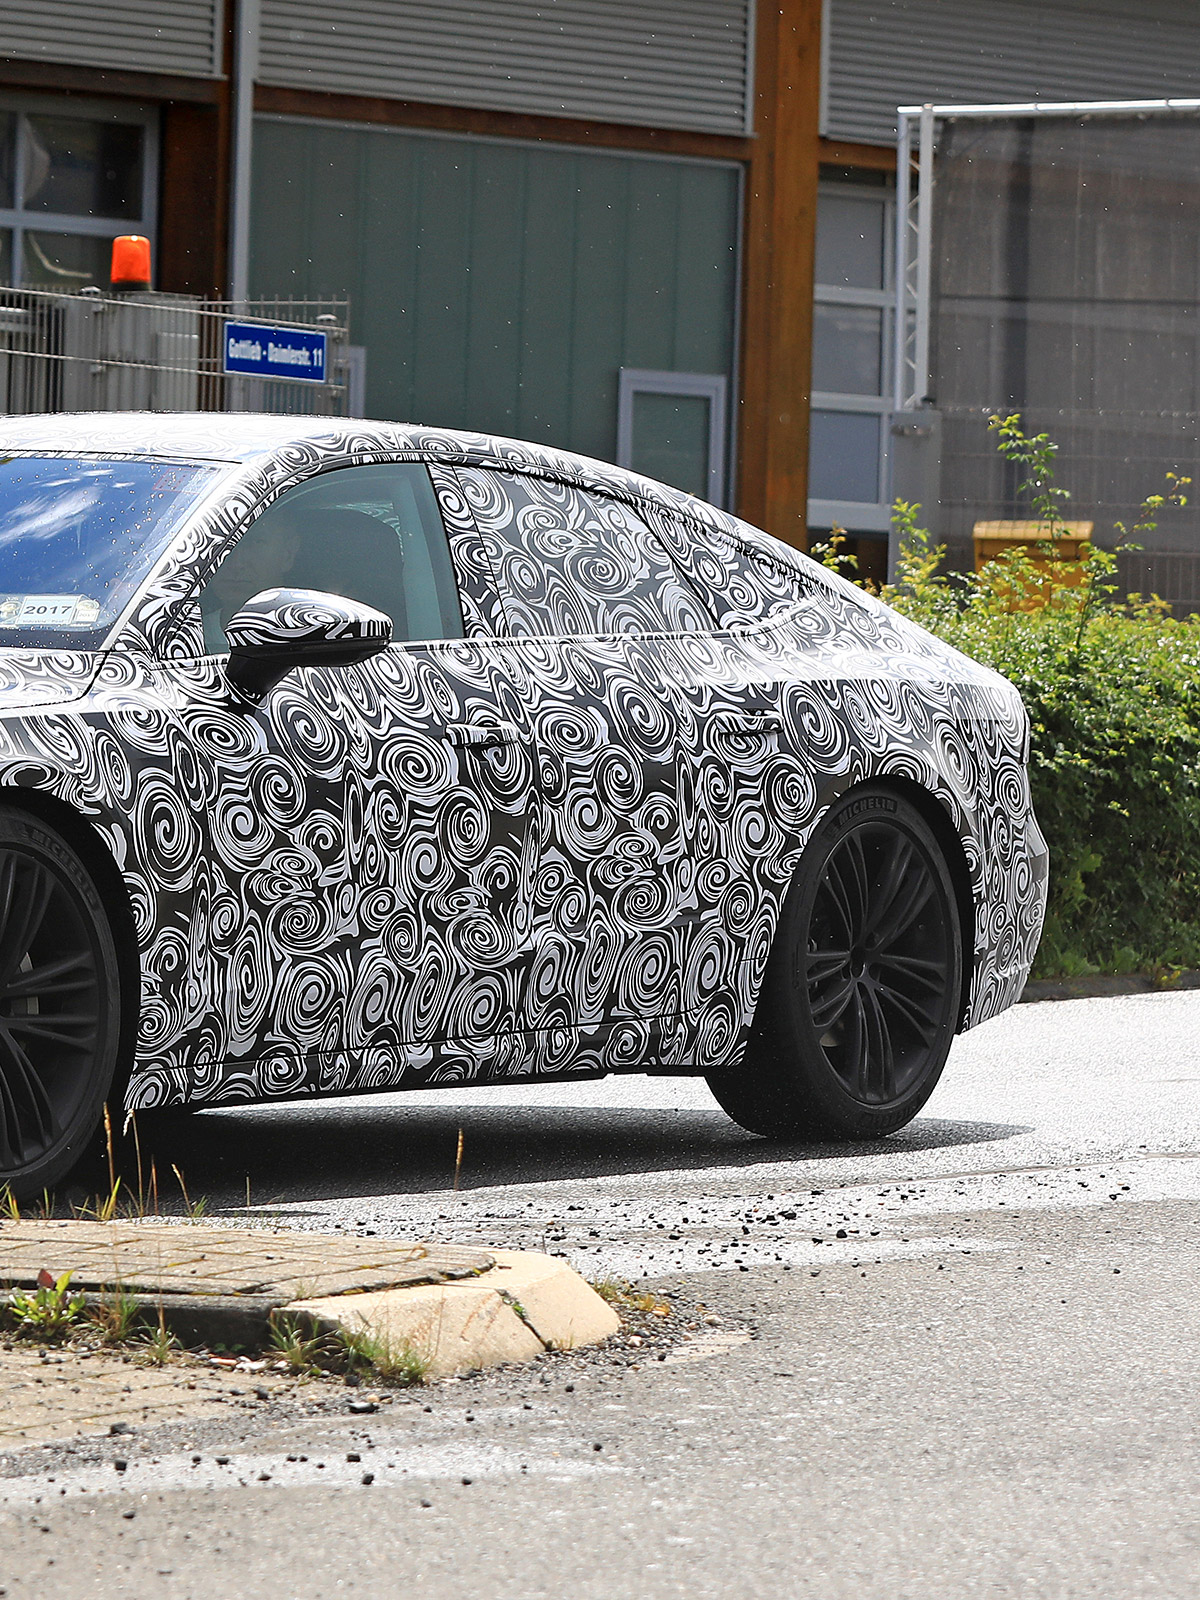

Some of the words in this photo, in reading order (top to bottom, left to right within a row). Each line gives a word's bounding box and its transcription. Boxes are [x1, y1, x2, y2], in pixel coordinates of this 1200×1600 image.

[312, 348, 323, 368] 11
[23, 605, 73, 615] 2017
[837, 797, 895, 827] MICHELIN
